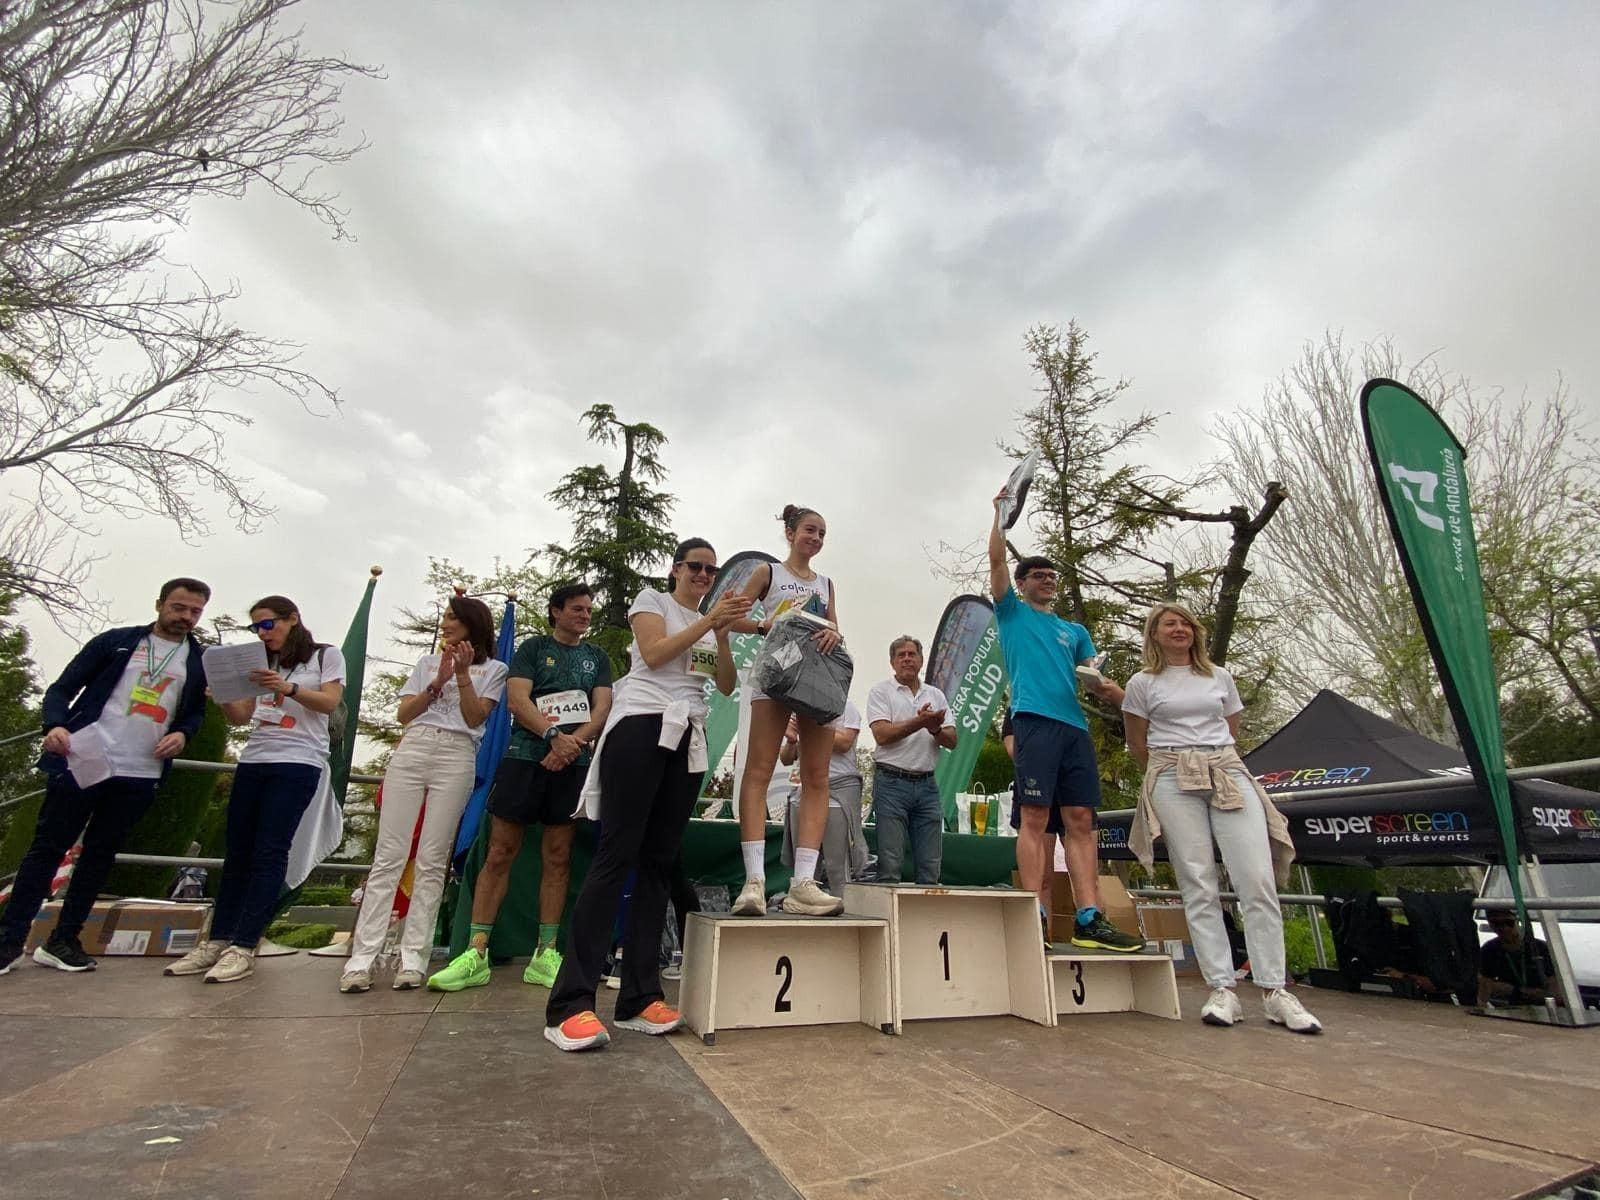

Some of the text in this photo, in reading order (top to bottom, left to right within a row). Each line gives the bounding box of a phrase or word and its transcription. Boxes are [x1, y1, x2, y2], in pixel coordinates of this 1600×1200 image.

[1440, 447, 1460, 513] Andalucía
[964, 627, 999, 684] POPULAR
[553, 702, 588, 714] 1449
[962, 663, 1003, 733] SALUD
[1305, 811, 1470, 842] superscreen
[1376, 833, 1470, 845] sport&events
[938, 931, 950, 981] 1
[774, 955, 793, 1013] 2
[1070, 960, 1086, 1006] 3
